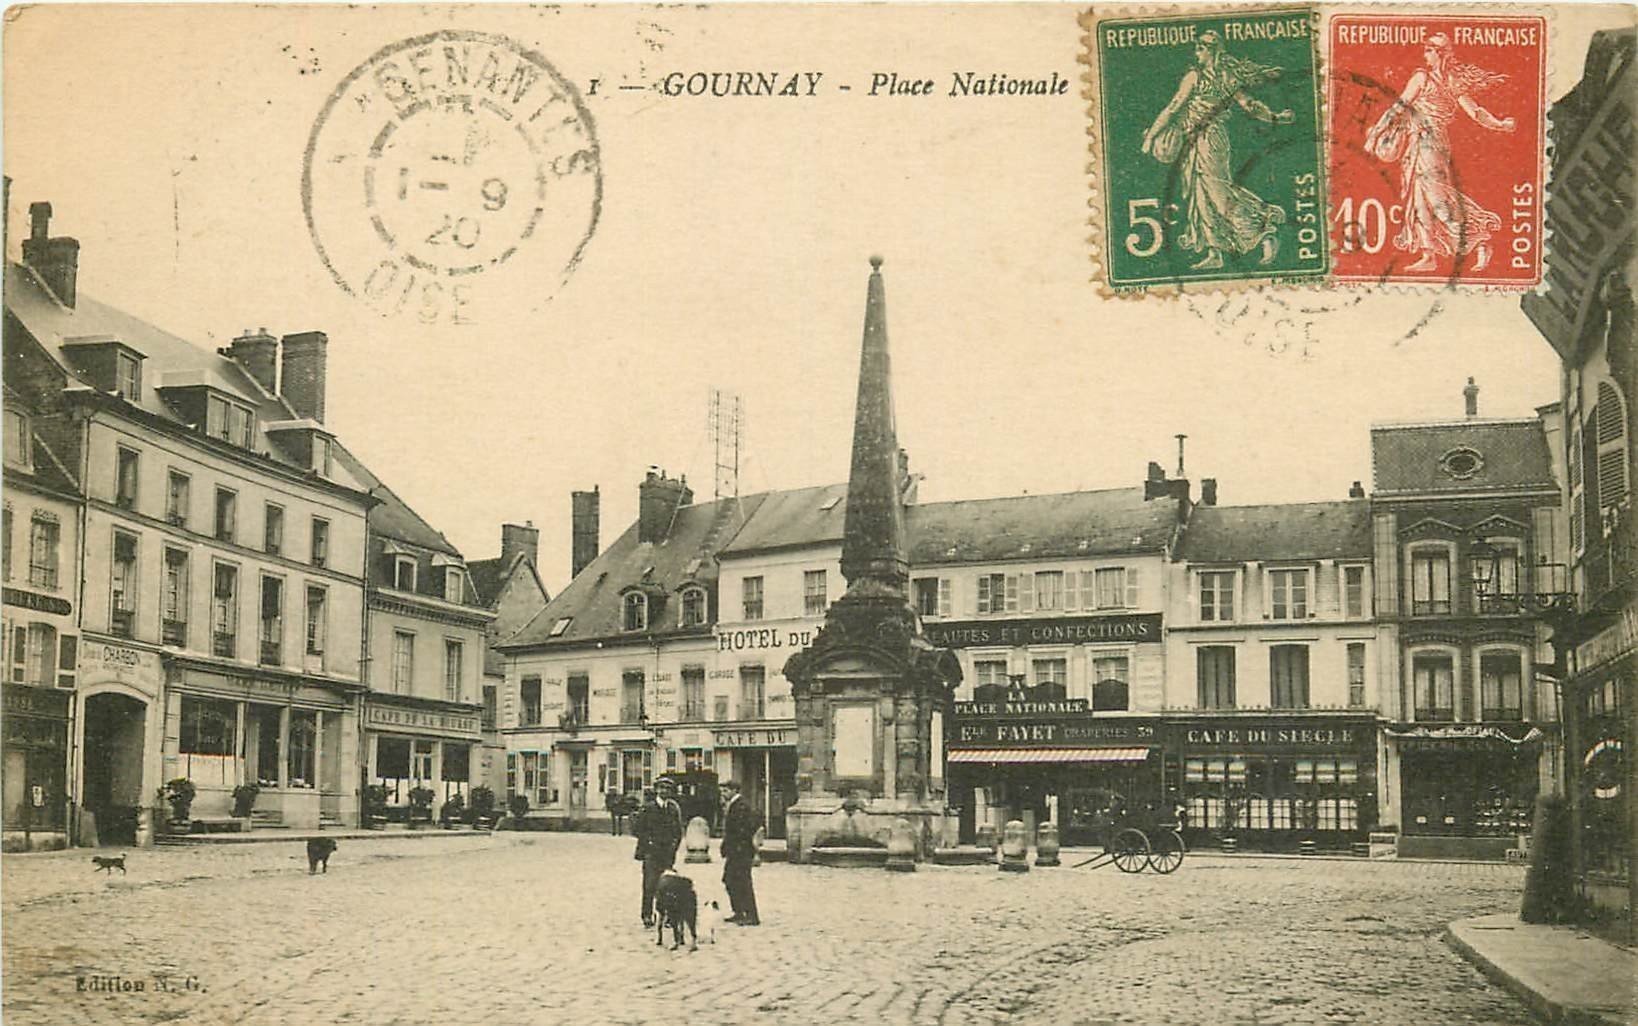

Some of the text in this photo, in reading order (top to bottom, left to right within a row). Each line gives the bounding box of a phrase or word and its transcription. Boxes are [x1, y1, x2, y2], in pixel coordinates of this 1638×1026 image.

[1106, 18, 1308, 48] REPUBLIQUE FRANÇAISE
[1338, 25, 1537, 47] REPUBLIQUE FRANÇAISE
[1296, 173, 1318, 260] POSTES
[1512, 181, 1533, 269] POSTES
[425, 213, 480, 249] 20
[719, 628, 811, 651] HOTEL DU
[1000, 627, 1020, 642] ET
[1031, 622, 1149, 640] CONFECTIONS
[954, 700, 1084, 715] PLACE NATIONALE
[716, 731, 786, 745] CAFE DU
[996, 725, 1057, 742] FAYET
[1187, 730, 1240, 744] CAFE
[1248, 729, 1271, 744] DU
